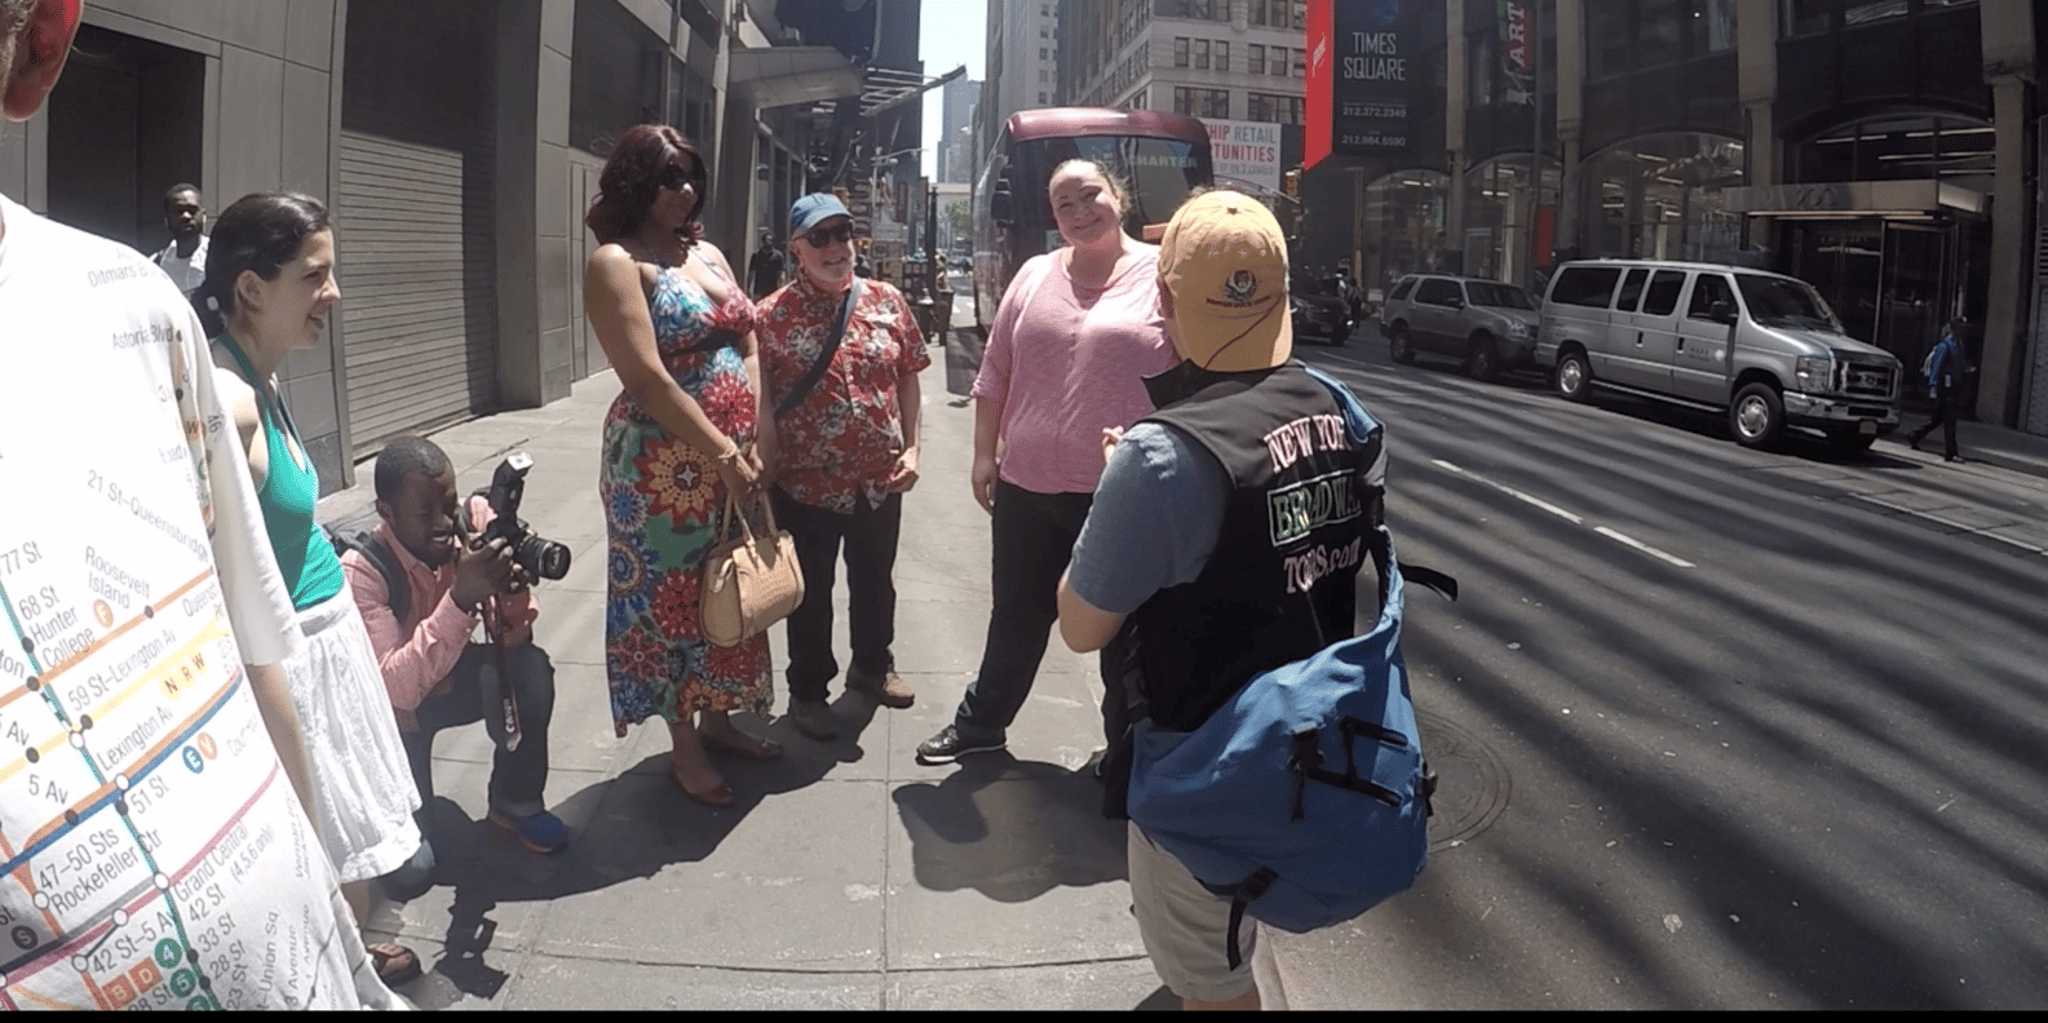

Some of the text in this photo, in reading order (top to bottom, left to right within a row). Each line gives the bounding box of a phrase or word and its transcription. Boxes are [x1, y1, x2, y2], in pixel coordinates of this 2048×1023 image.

[1352, 31, 1397, 54] TIMES
[1343, 57, 1406, 81] SQUARE
[1234, 126, 1277, 144] RETAIL
[1263, 416, 1314, 474] NEW
[87, 469, 104, 493] 21
[0, 540, 43, 575] 77 St
[85, 546, 150, 599] Roosevelt
[18, 584, 61, 621] 68 St
[88, 571, 130, 609] Island
[28, 606, 79, 646] Hunter
[41, 627, 96, 668] College
[67, 682, 91, 712] 59
[162, 628, 177, 646] Av
[6, 720, 30, 746] Av
[503, 698, 516, 734] Canon
[97, 705, 174, 772] Lexington Av
[28, 773, 69, 805] 5 Av
[129, 773, 171, 815] 51 St
[88, 827, 121, 854] Sts
[172, 850, 212, 902] Grand
[208, 818, 250, 867] Central
[51, 846, 139, 916] Rockefeller
[188, 882, 226, 923] 42 St
[197, 911, 237, 953] 33 St
[93, 949, 118, 975] 42
[209, 939, 247, 980] 28 St
[150, 983, 174, 1007] St
[226, 964, 249, 1010] 23 St
